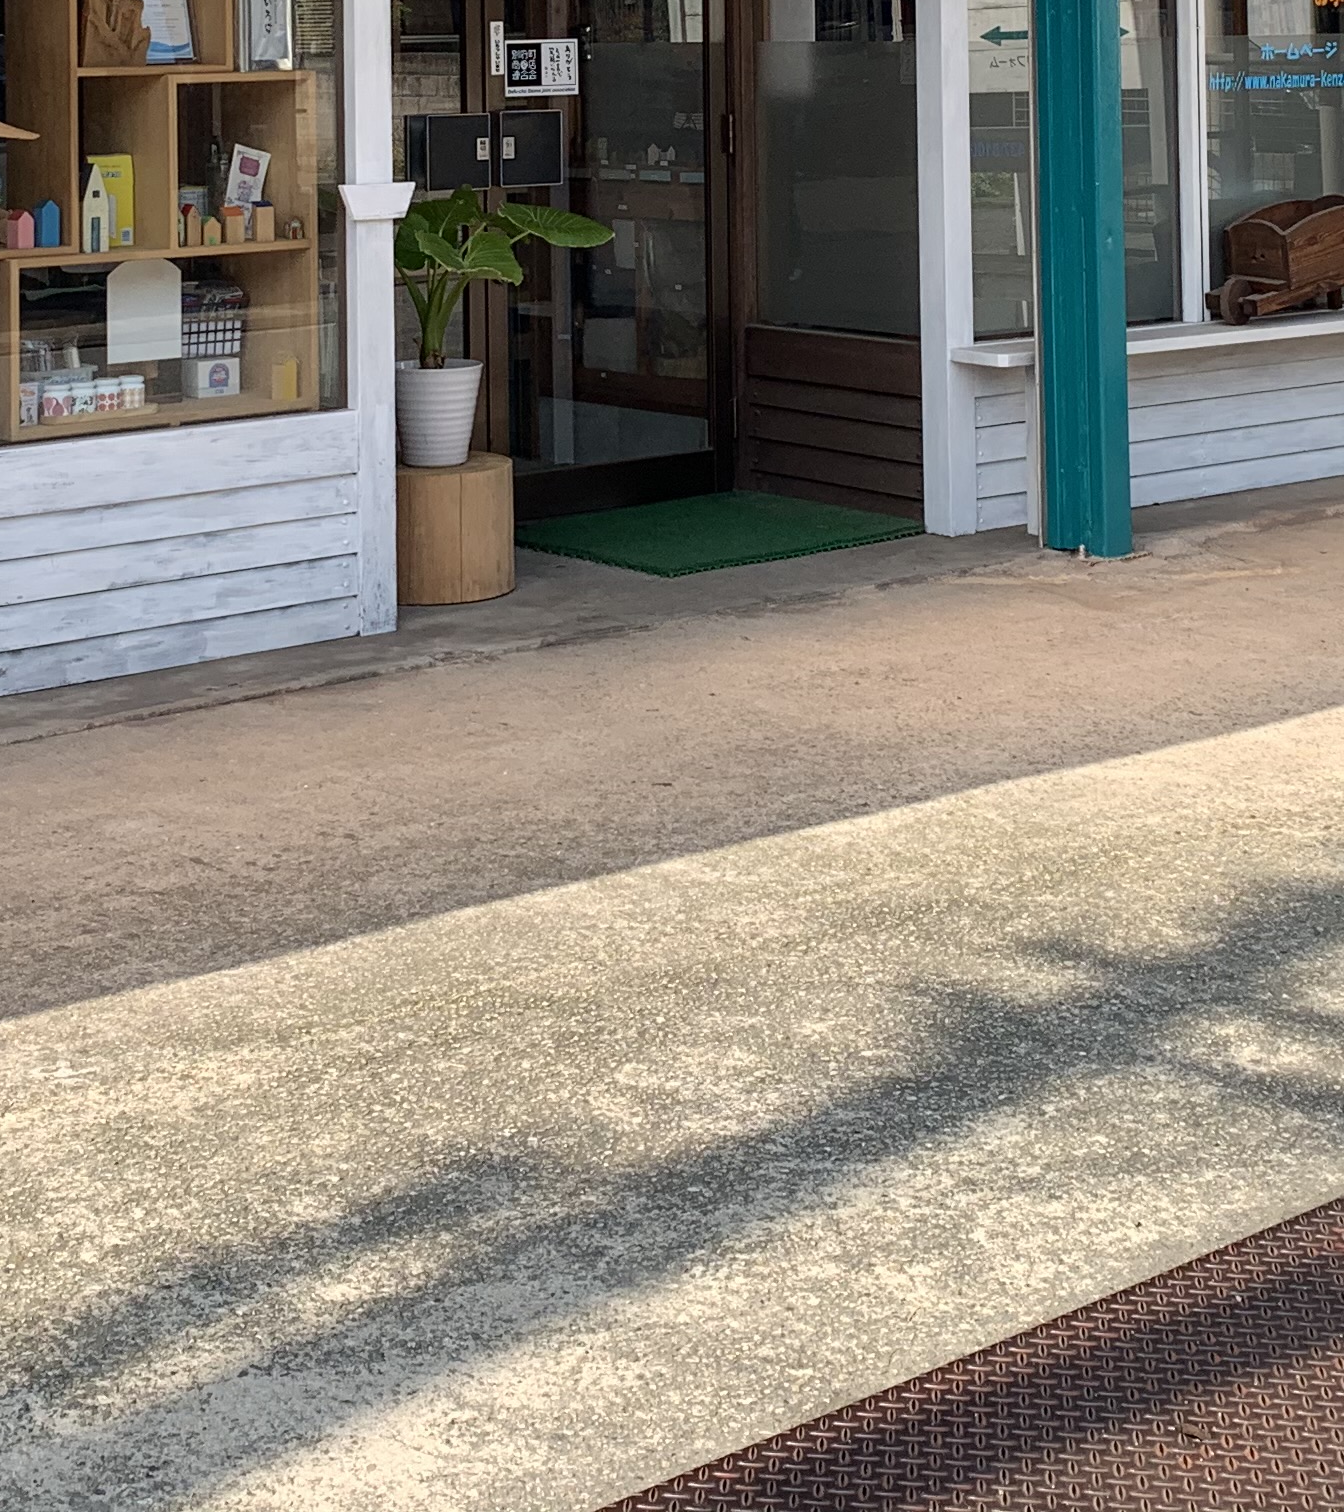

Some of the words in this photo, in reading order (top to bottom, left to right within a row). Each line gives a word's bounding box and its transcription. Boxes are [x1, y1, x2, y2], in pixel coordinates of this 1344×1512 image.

[1260, 41, 1338, 61] ホームページ
